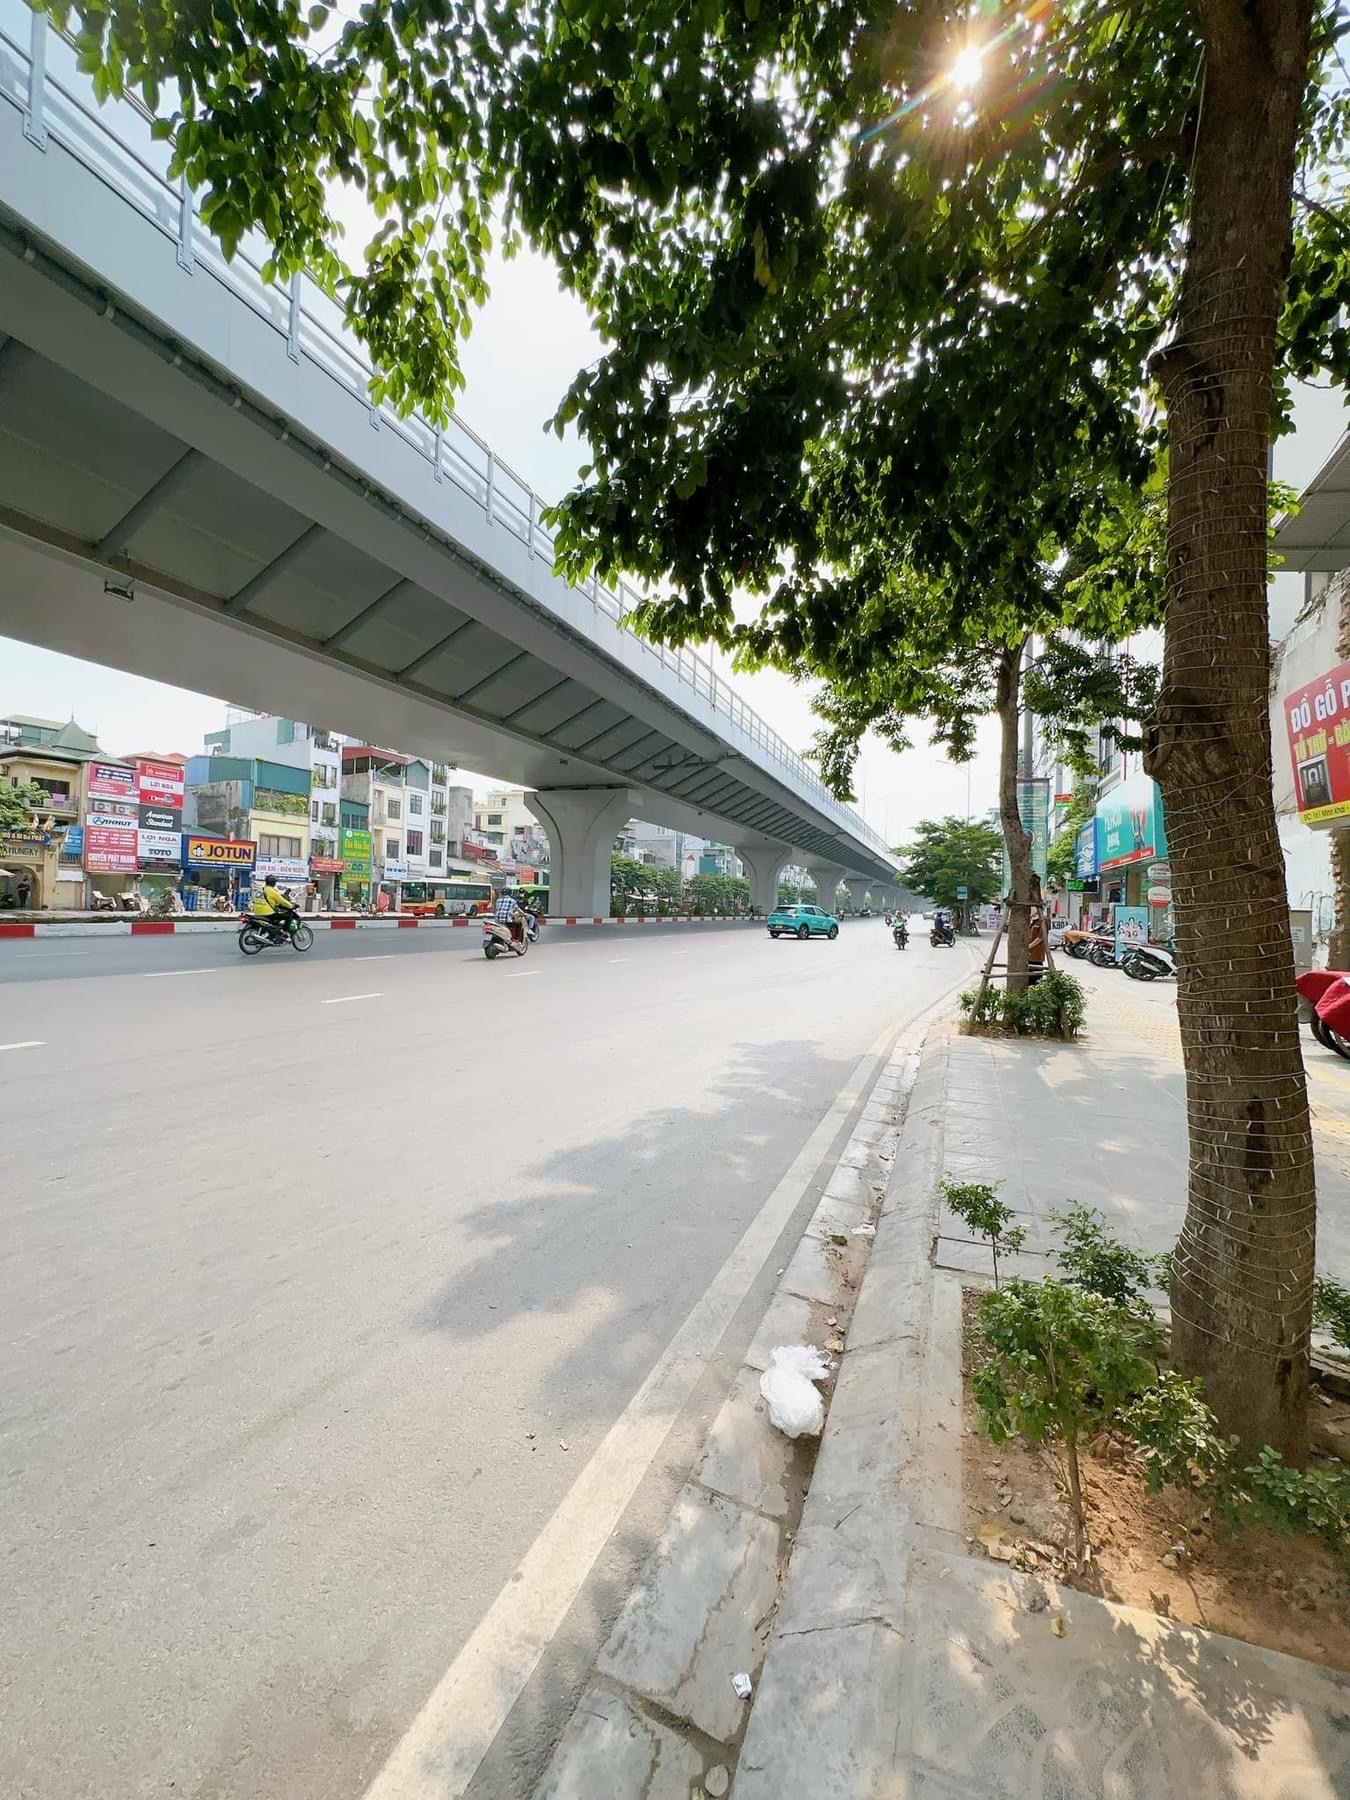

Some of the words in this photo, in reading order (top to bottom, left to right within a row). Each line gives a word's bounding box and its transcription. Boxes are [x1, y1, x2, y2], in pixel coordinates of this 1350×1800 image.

[1290, 693, 1311, 733] ĐỒ
[1314, 678, 1337, 721] GỖ
[148, 848, 172, 856] TOTO
[207, 845, 251, 860] JOTUN
